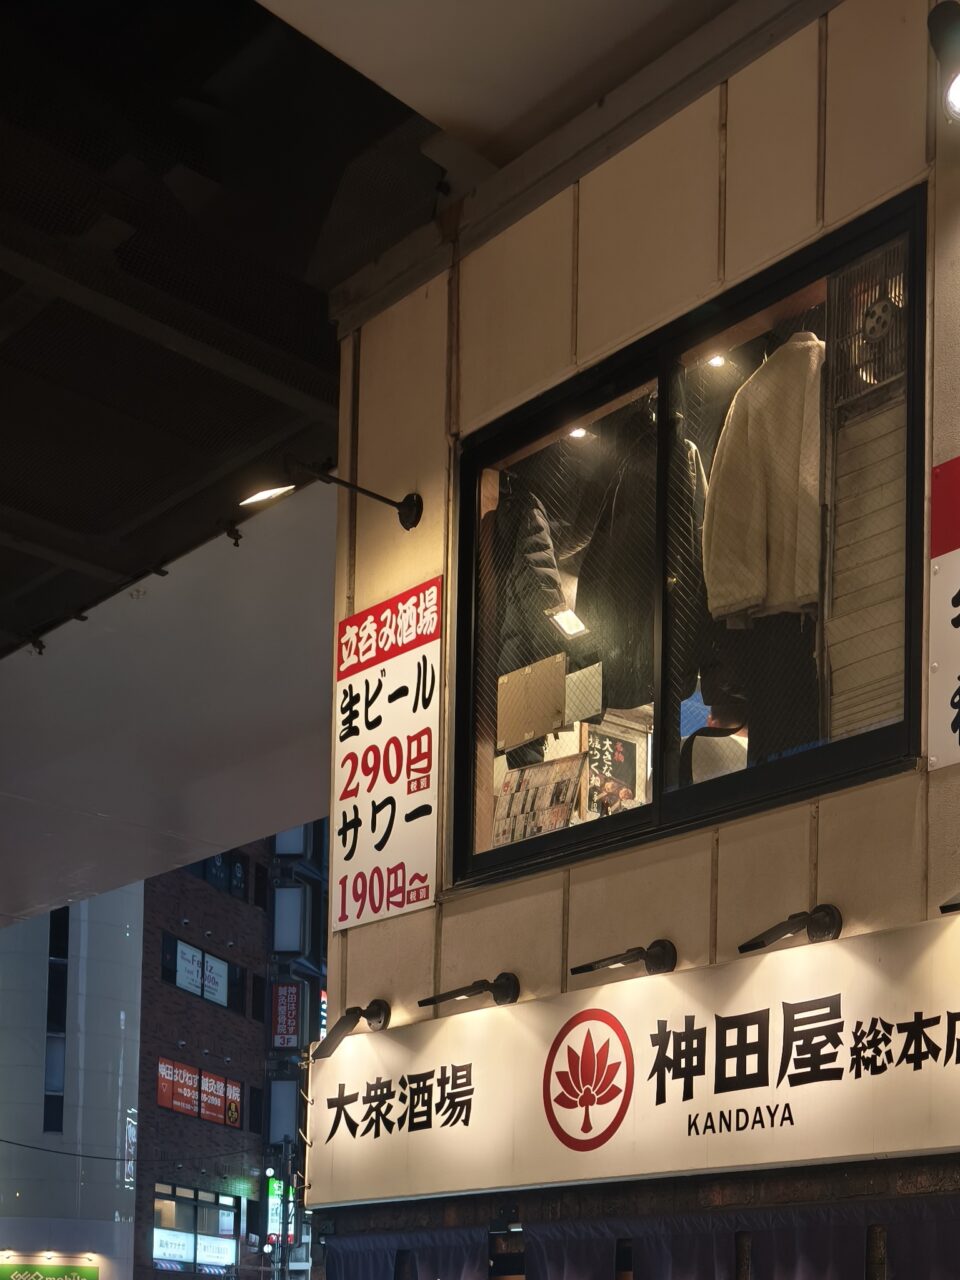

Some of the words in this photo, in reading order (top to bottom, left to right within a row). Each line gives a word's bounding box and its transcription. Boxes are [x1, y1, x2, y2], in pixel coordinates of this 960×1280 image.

[339, 586, 438, 672] 立呑み酒場
[339, 654, 435, 742] 生ビール
[339, 727, 432, 800] 290円
[338, 796, 432, 861] サワー
[325, 1063, 476, 1144] 大衆酒場
[687, 1104, 795, 1137] KANDAYA
